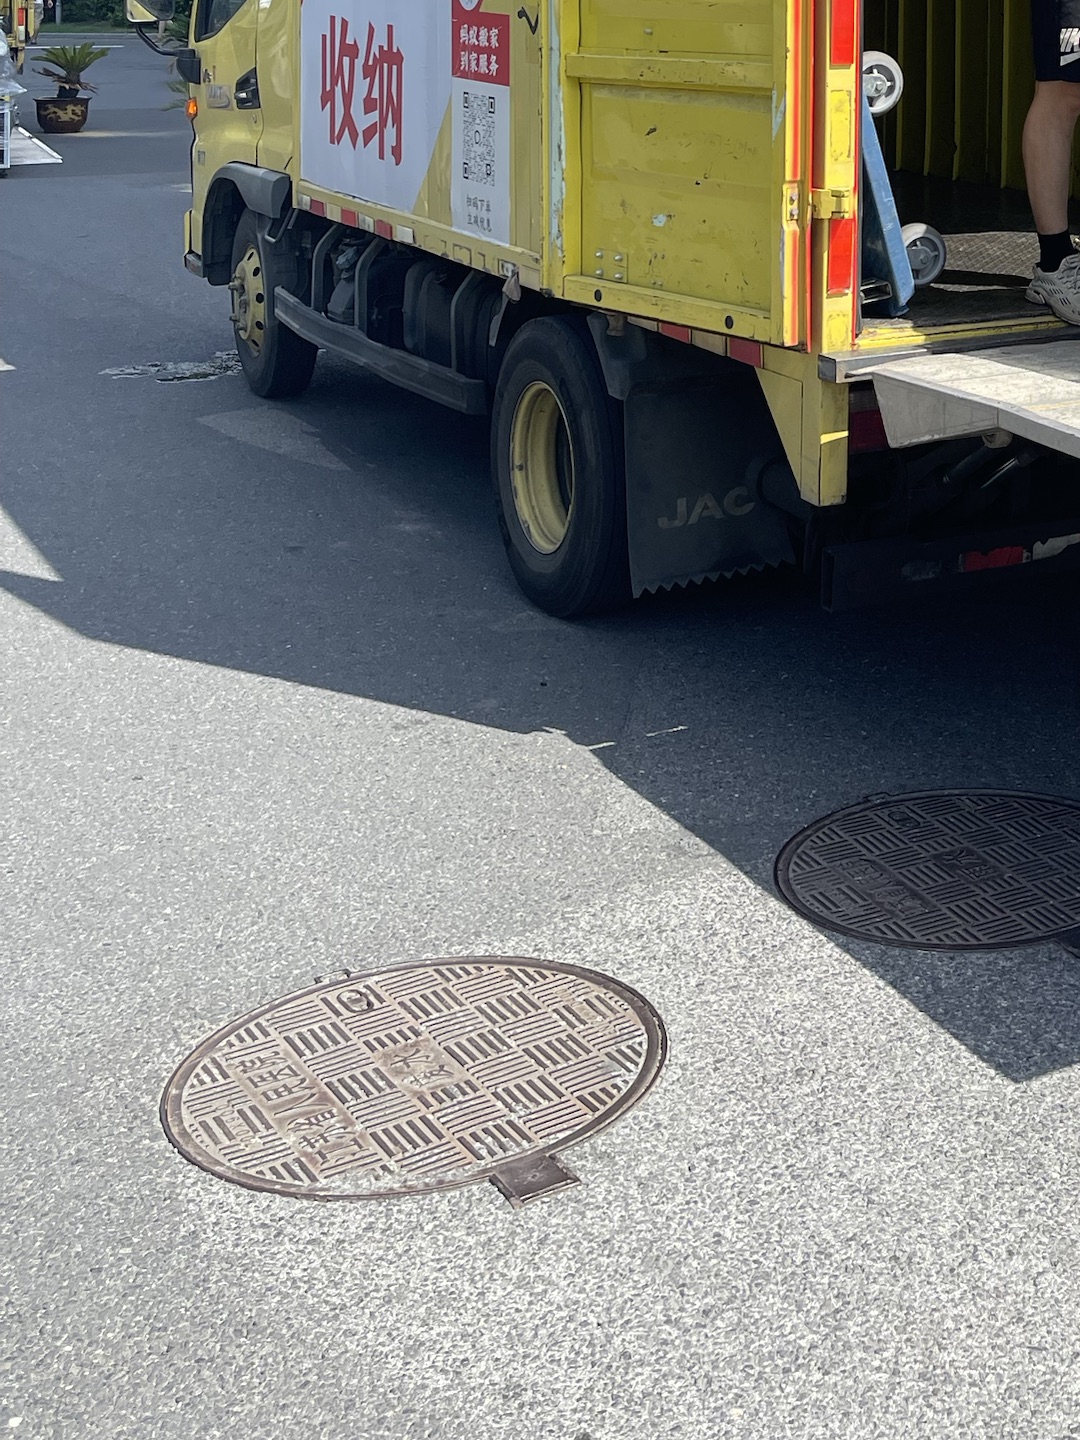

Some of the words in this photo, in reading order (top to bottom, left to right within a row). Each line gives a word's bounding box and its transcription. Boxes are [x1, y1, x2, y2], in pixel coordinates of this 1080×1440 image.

[459, 23, 500, 49] 蚂蚁搬家
[459, 51, 500, 76] 到家服务
[320, 14, 404, 166] 收纳
[657, 486, 755, 529] JAC
[233, 1050, 373, 1166] 江苏省人民医院
